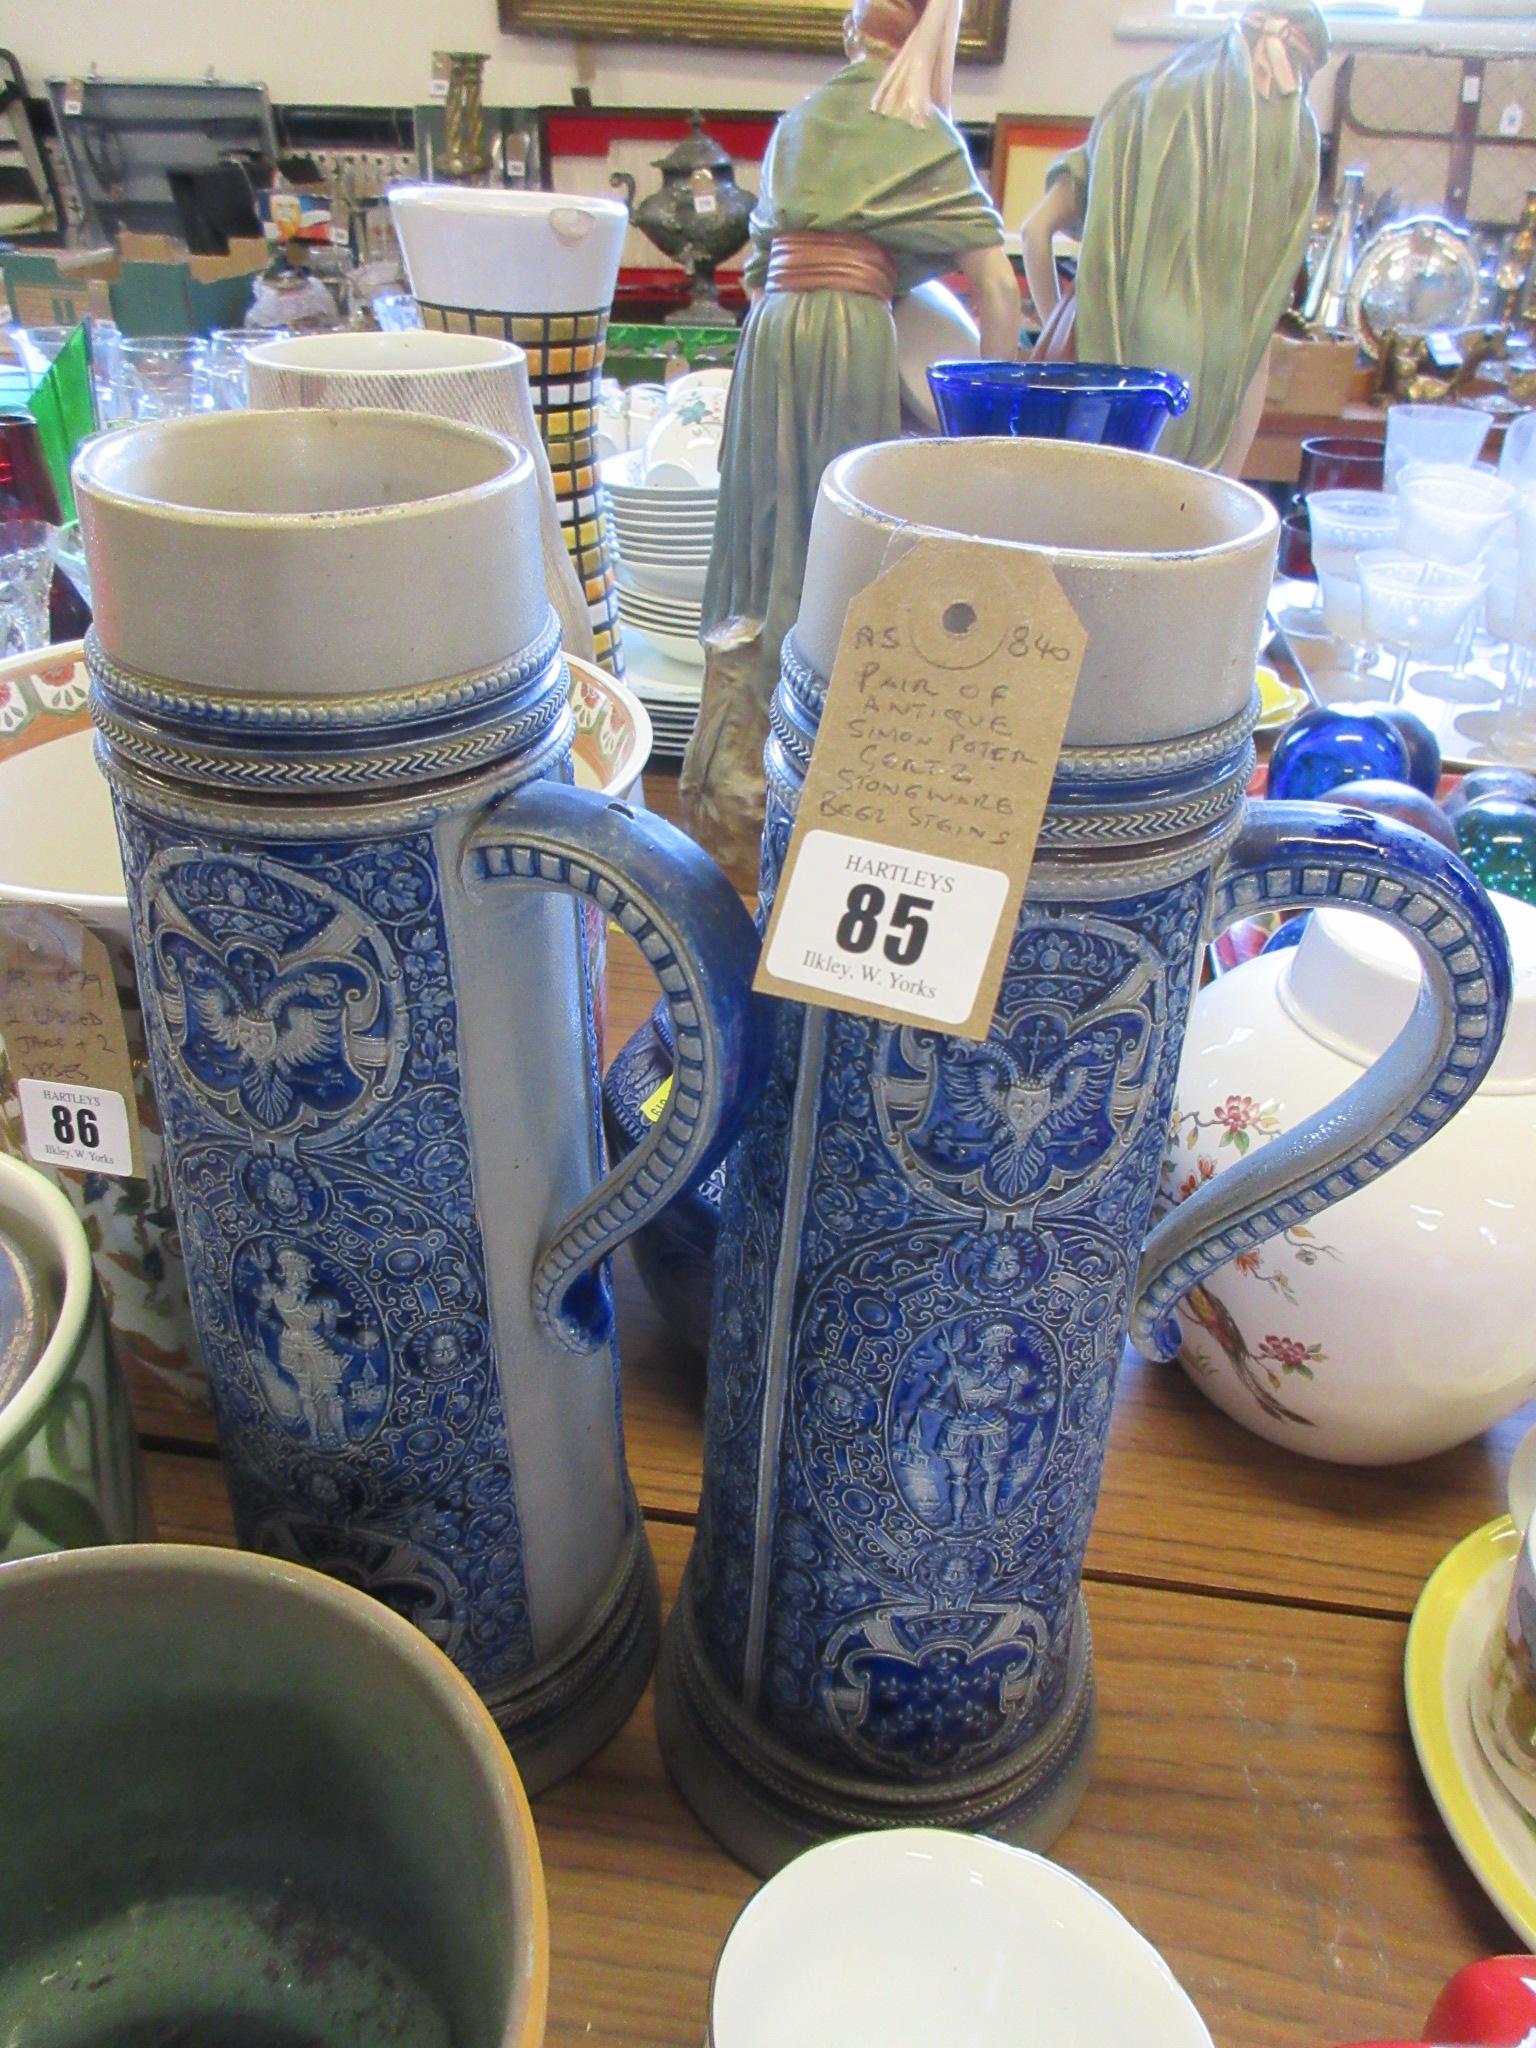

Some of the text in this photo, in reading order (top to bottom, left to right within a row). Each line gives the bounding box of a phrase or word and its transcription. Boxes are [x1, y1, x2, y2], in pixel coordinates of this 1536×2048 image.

[856, 626, 900, 650] AS
[1007, 625, 1071, 662] 840
[859, 661, 1009, 707] PAIR OF
[848, 719, 933, 746] SIMON
[864, 695, 1013, 737] ANTIQUE
[838, 769, 1014, 816] STONEWARE
[820, 790, 1011, 845] BEER STEINS
[845, 854, 956, 894] HARTLEYS
[836, 883, 935, 967] 85
[862, 965, 882, 986] W.
[889, 971, 937, 999] Yorks
[97, 1034, 118, 1054] 2
[43, 1089, 101, 1107] HARTLEYS
[51, 1105, 100, 1149] 86
[88, 1151, 115, 1165] Yorks
